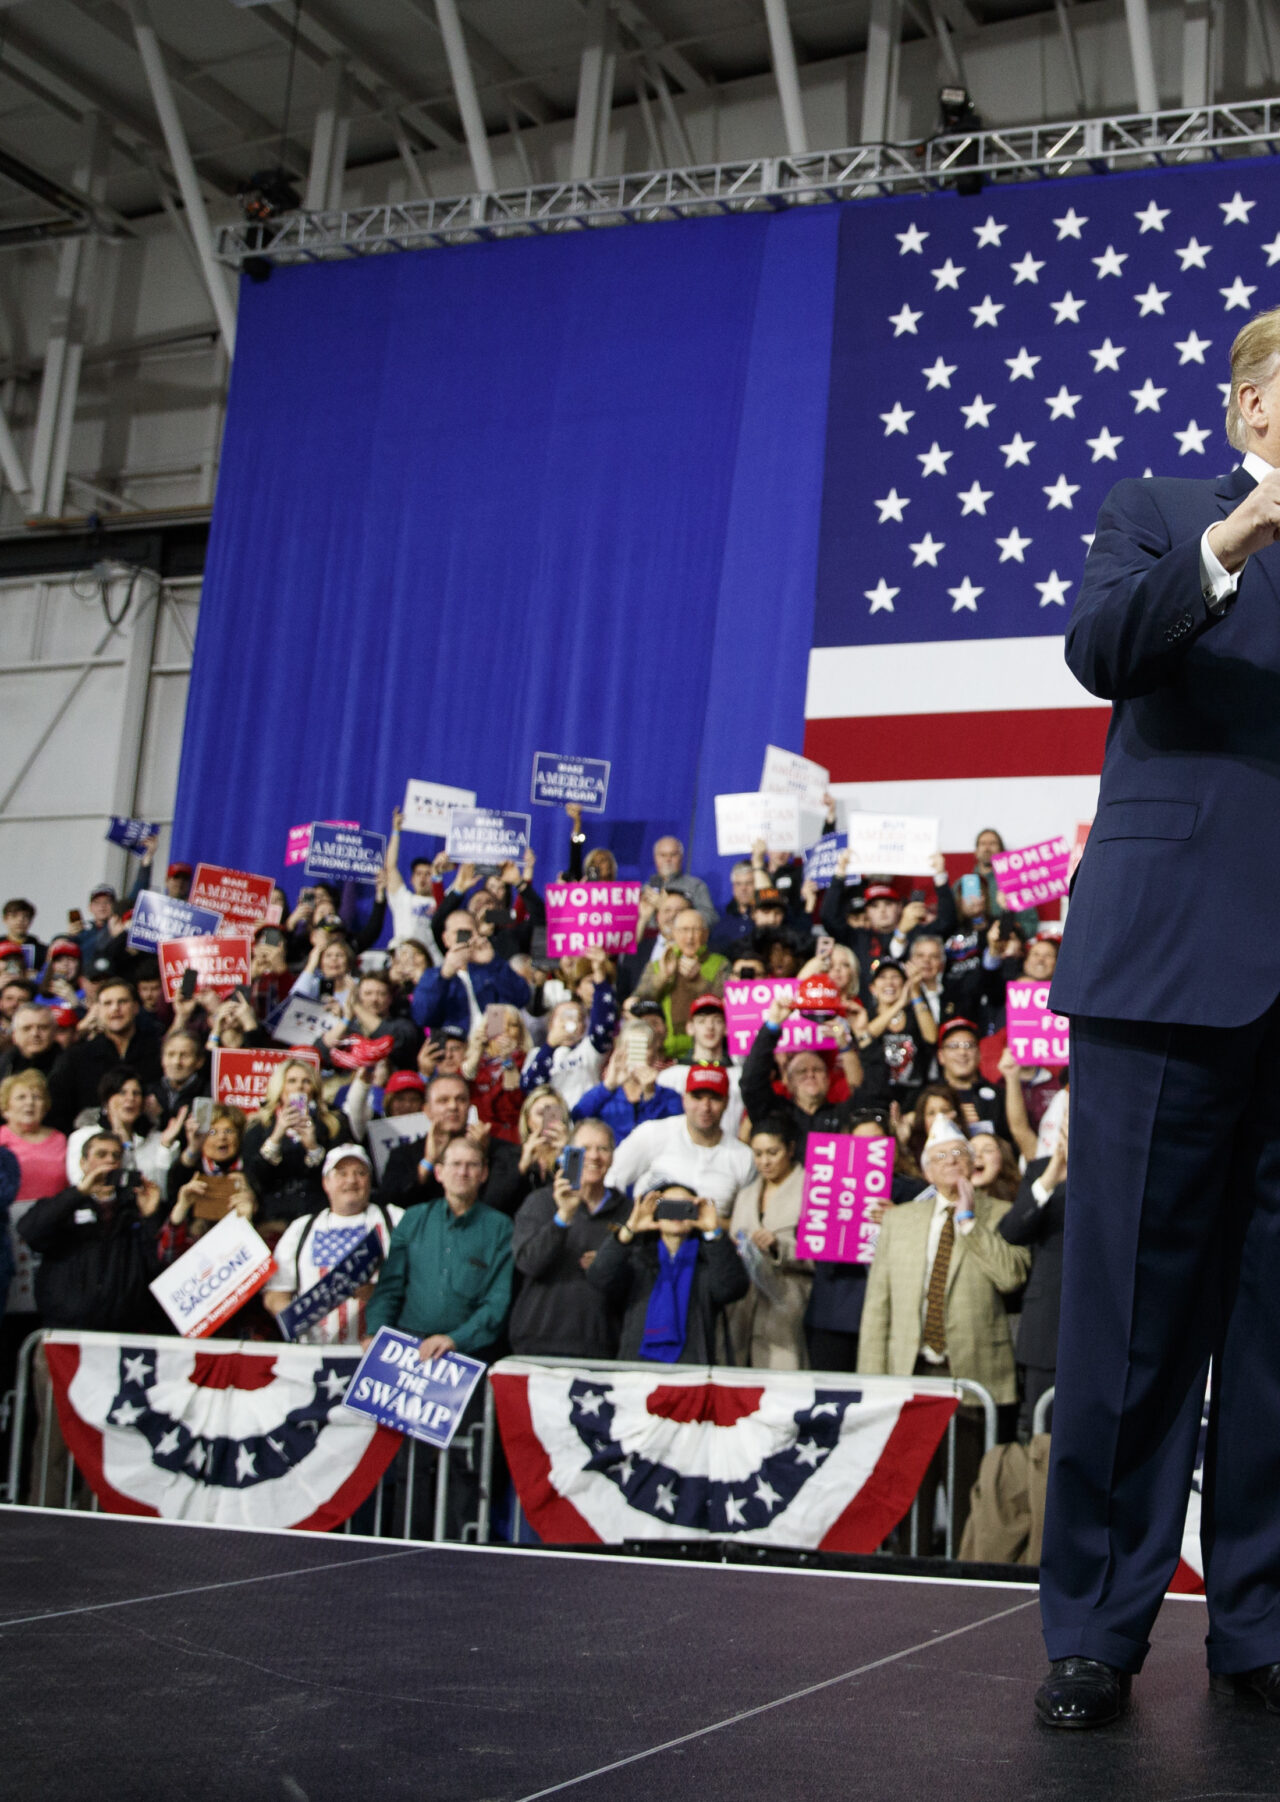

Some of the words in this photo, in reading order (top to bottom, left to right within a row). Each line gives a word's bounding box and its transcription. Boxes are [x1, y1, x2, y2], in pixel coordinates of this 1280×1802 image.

[536, 771, 605, 792] AMERICA
[566, 788, 597, 802] AGAIN
[453, 826, 527, 846] AMERICA
[311, 839, 383, 863] AMERICA
[992, 839, 1069, 875] WOMEN
[1019, 866, 1050, 885] FOR
[194, 883, 269, 909] AMERICA
[546, 887, 641, 908] WOMEN
[577, 911, 613, 927] FOR
[552, 931, 634, 952] TRUMP
[207, 974, 243, 986] AGAIN
[725, 984, 794, 1006] WOM
[294, 1011, 333, 1031] TRU
[1041, 1016, 1069, 1031] FO
[1012, 1037, 1069, 1059] TRU
[804, 1141, 836, 1254] TRUMP
[837, 1176, 857, 1221] FOR
[179, 1246, 253, 1317] SACCONE
[380, 1339, 468, 1388] DRAIN
[396, 1370, 431, 1397] THE
[354, 1376, 452, 1430] SWAMP
